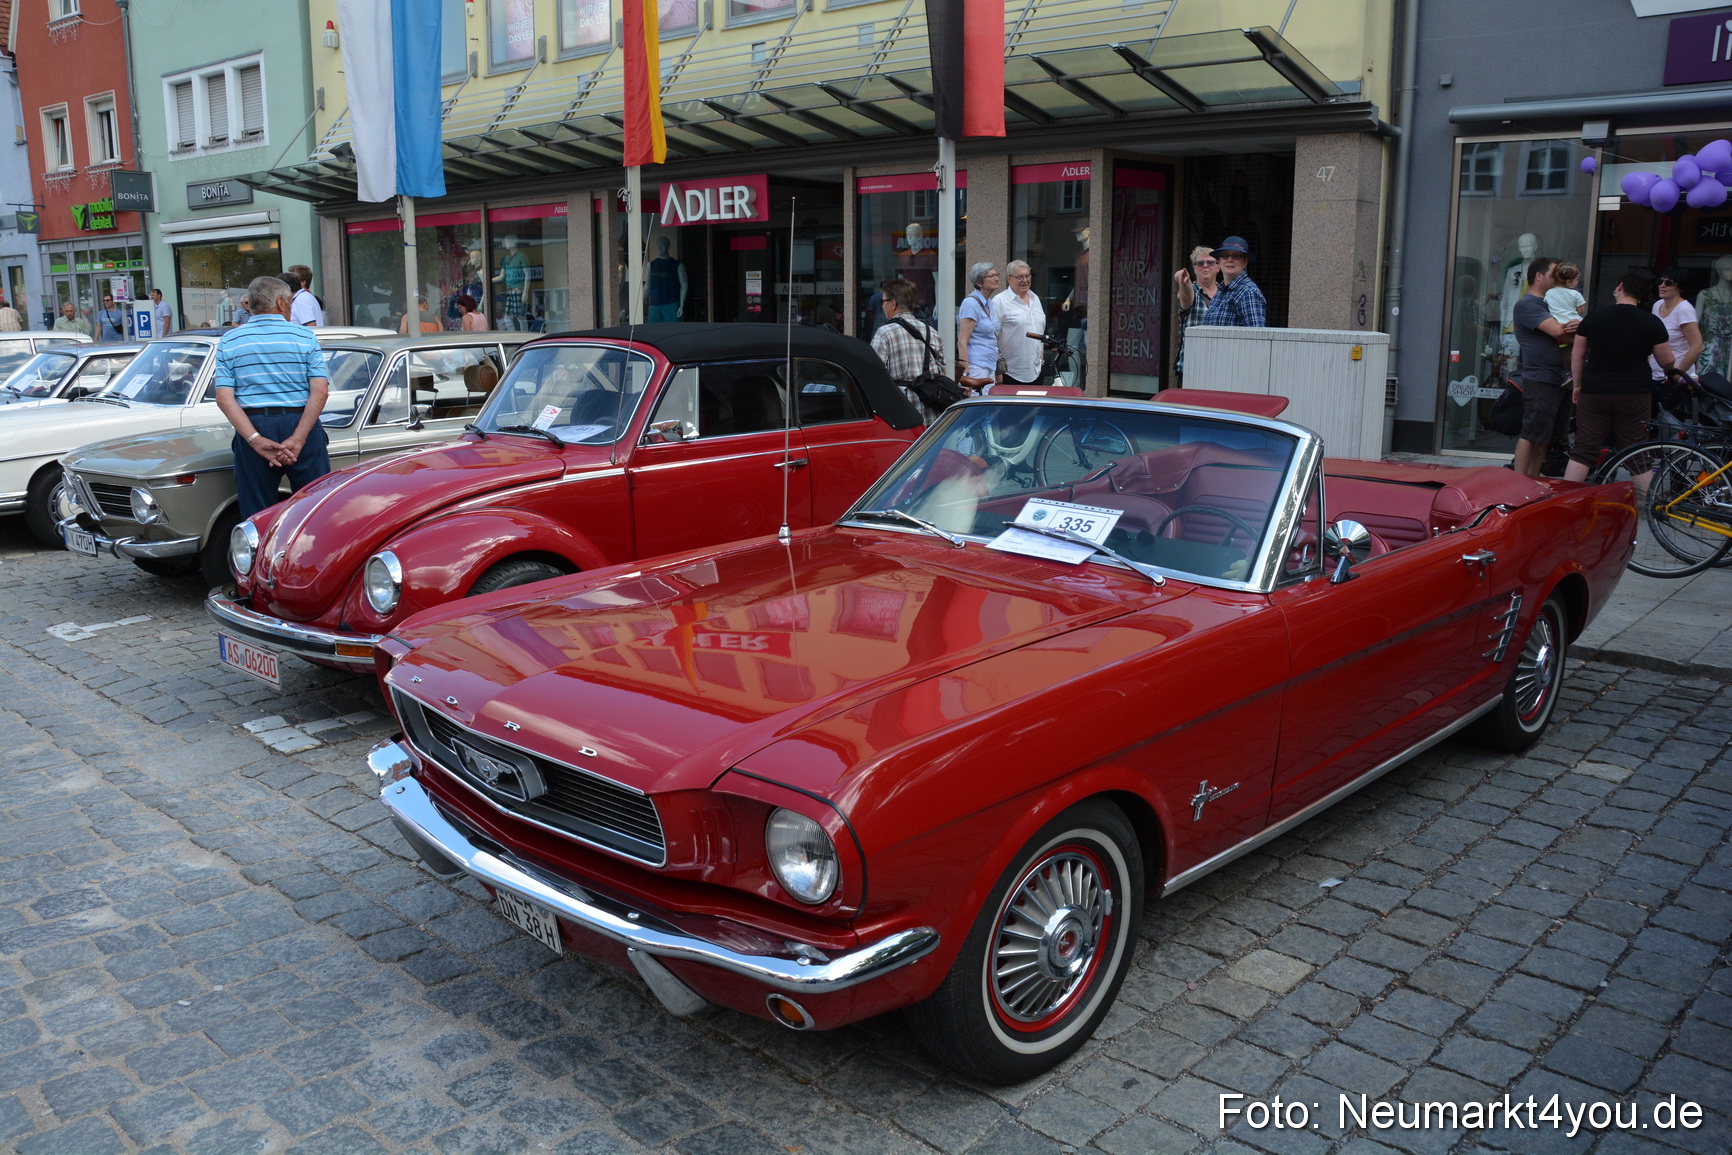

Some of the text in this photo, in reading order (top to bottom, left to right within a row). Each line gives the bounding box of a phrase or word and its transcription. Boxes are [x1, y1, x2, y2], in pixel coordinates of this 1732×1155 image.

[579, 15, 595, 29] DAS
[508, 33, 522, 44] DAS
[1061, 166, 1090, 177] ADLER
[1316, 165, 1336, 182] 47
[117, 192, 149, 202] BONITA
[201, 182, 229, 200] BONITA
[660, 183, 752, 225] ADLER
[1119, 261, 1146, 280] WIR
[140, 314, 149, 327] P
[1118, 312, 1145, 332] DAS
[1059, 516, 1096, 533] 335
[228, 641, 277, 679] AS 06200
[544, 922, 556, 949] H
